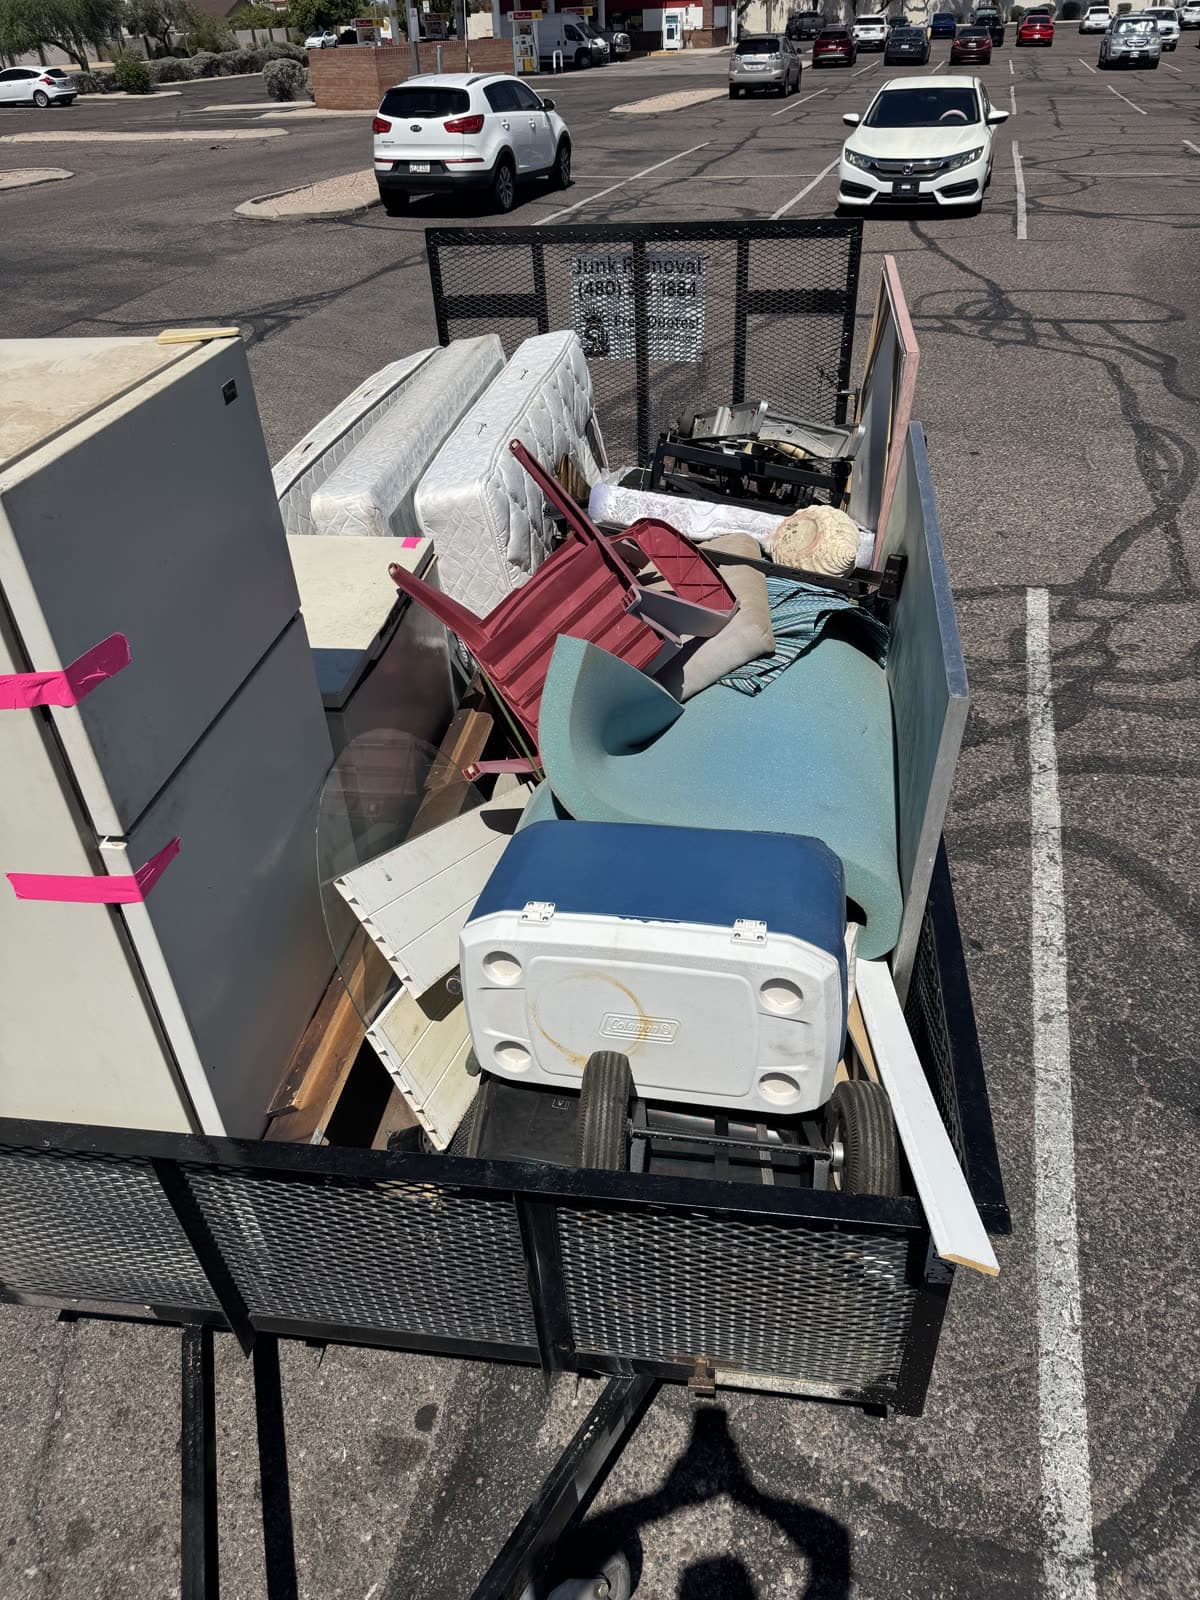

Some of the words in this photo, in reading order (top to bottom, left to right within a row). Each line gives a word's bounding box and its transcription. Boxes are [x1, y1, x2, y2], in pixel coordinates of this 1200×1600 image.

[572, 256, 617, 275] Junk
[622, 256, 702, 275] Rmoval
[578, 280, 621, 301] (480)
